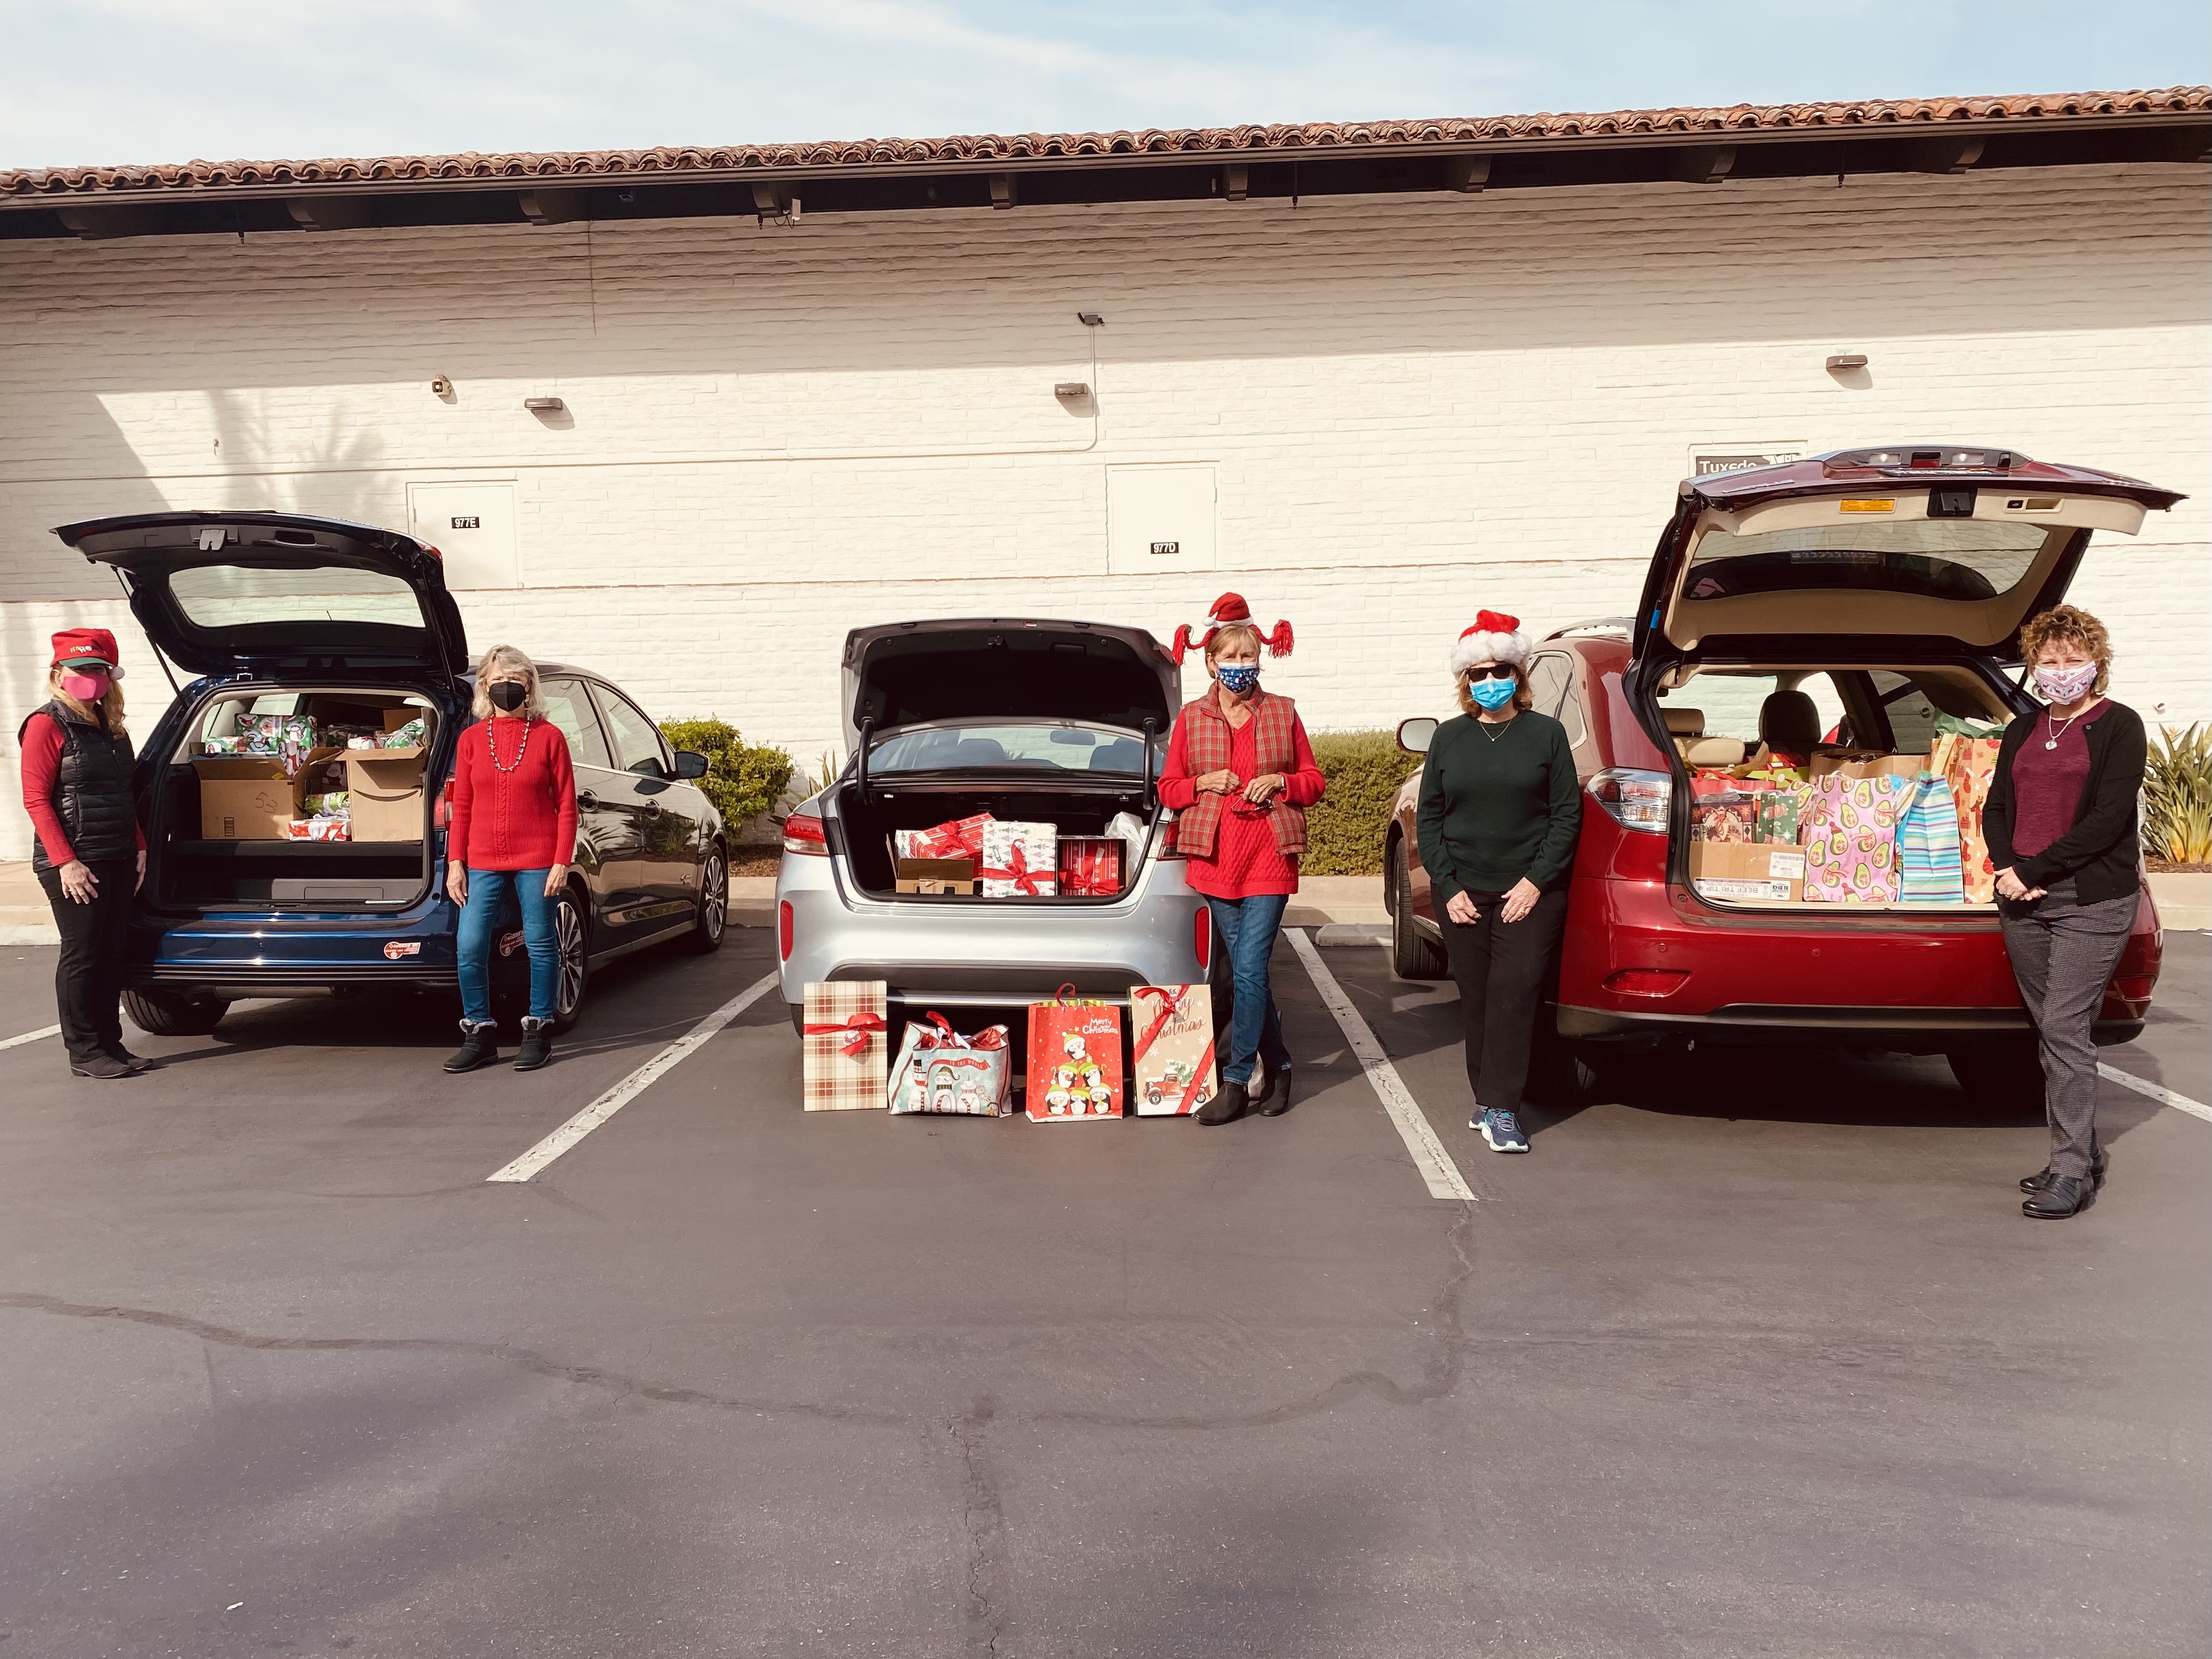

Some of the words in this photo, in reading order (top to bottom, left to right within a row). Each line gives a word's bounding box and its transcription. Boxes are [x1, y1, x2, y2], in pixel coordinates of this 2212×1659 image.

[455, 518, 476, 528] 977E
[1154, 542, 1176, 553] 977D
[255, 791, 278, 813] 53
[1090, 1017, 1113, 1028] Merry
[1082, 1024, 1119, 1035] Christmas
[967, 1060, 983, 1069] WORLD
